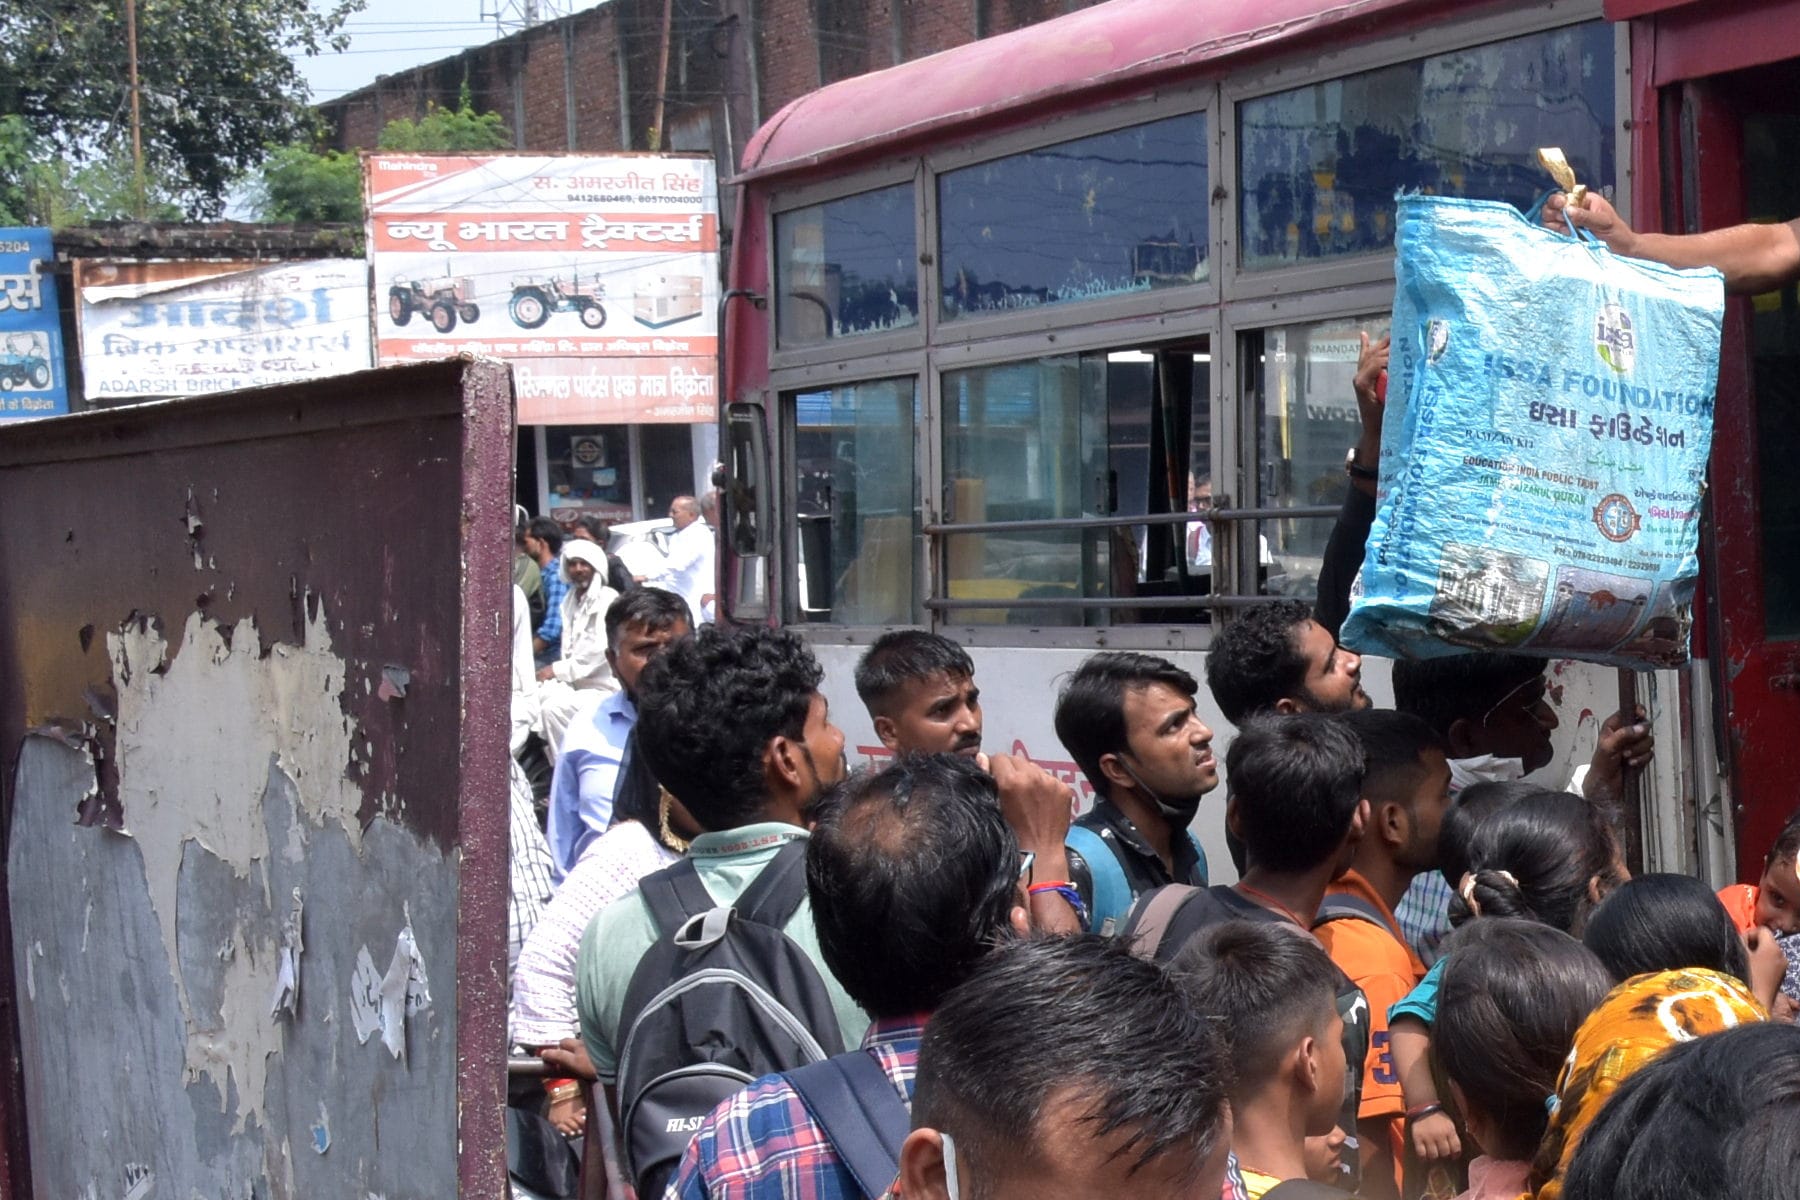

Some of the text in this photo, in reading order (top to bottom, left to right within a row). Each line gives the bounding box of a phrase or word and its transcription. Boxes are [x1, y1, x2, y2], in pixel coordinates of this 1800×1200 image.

[378, 160, 438, 172] Mahindra
[566, 172, 655, 191] अमरजीत
[662, 173, 701, 194] सिंह
[386, 221, 457, 251] न्यू
[459, 220, 570, 242] भारत
[121, 287, 334, 331] आदर्श
[99, 377, 177, 393] ADARSH
[610, 374, 637, 400] एक
[639, 375, 667, 398] मात्र
[1563, 369, 1715, 418] FOUNDATION
[1516, 464, 1540, 479] INDIA
[1541, 470, 1574, 485] PUBLIC
[1577, 477, 1599, 491] TRUST
